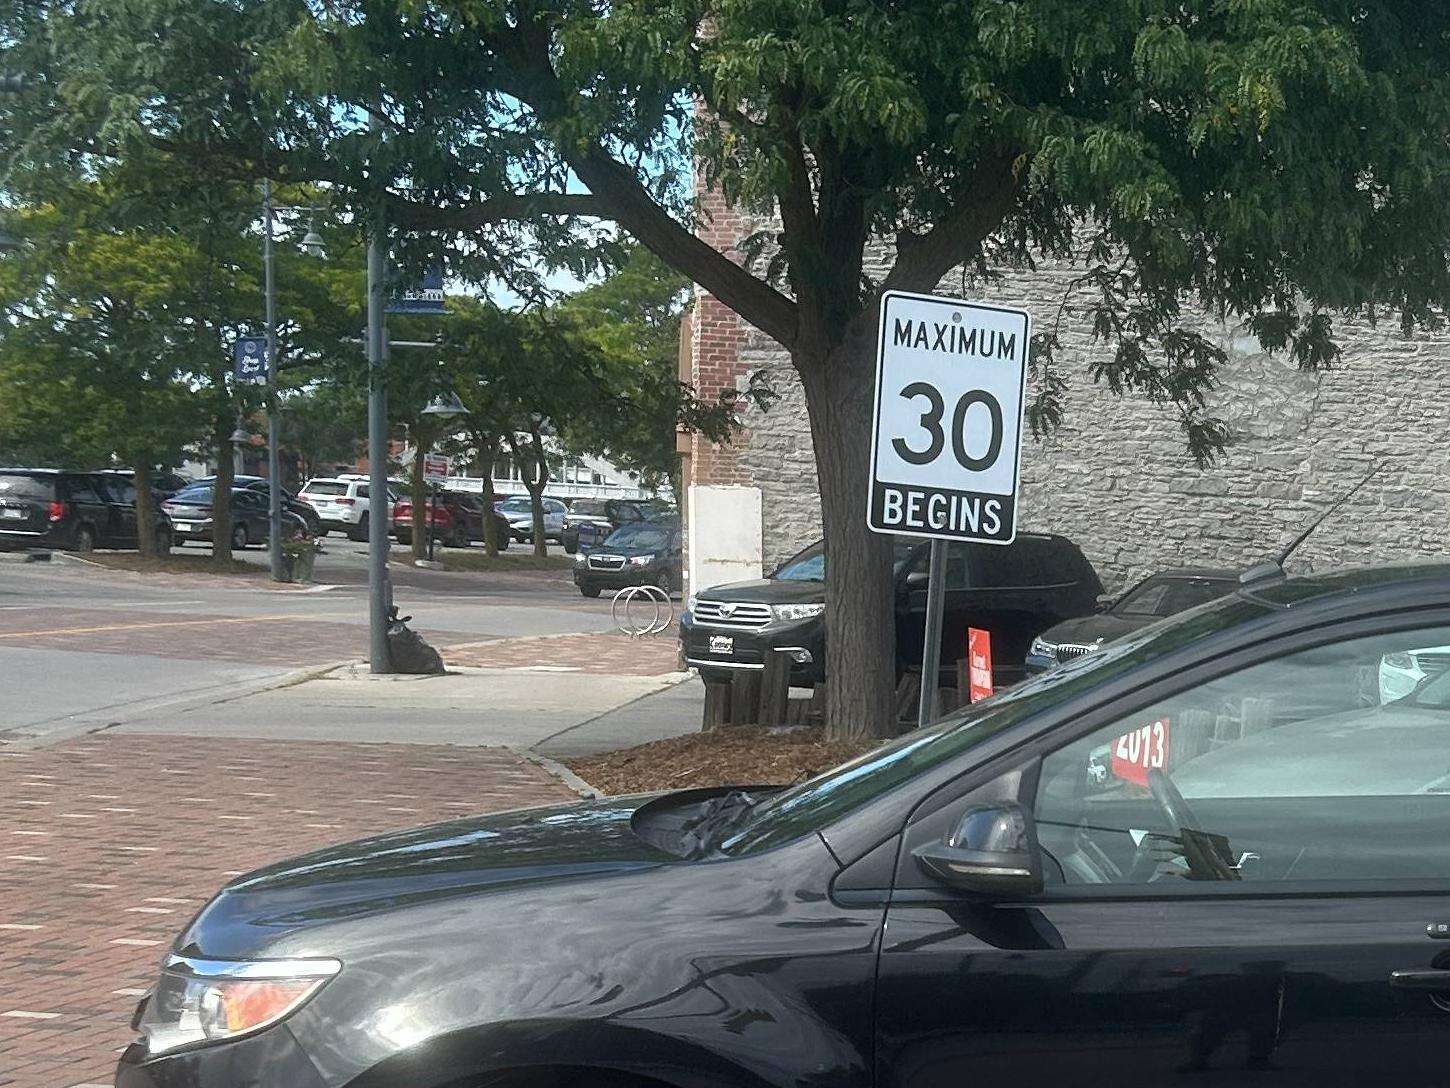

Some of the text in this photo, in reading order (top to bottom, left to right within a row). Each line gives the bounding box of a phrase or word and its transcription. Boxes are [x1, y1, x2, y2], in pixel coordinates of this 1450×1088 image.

[893, 318, 1016, 361] MAXIMUM
[891, 381, 1004, 472] 30
[882, 488, 1002, 535] BEGINS
[1116, 721, 1165, 769] 2013
